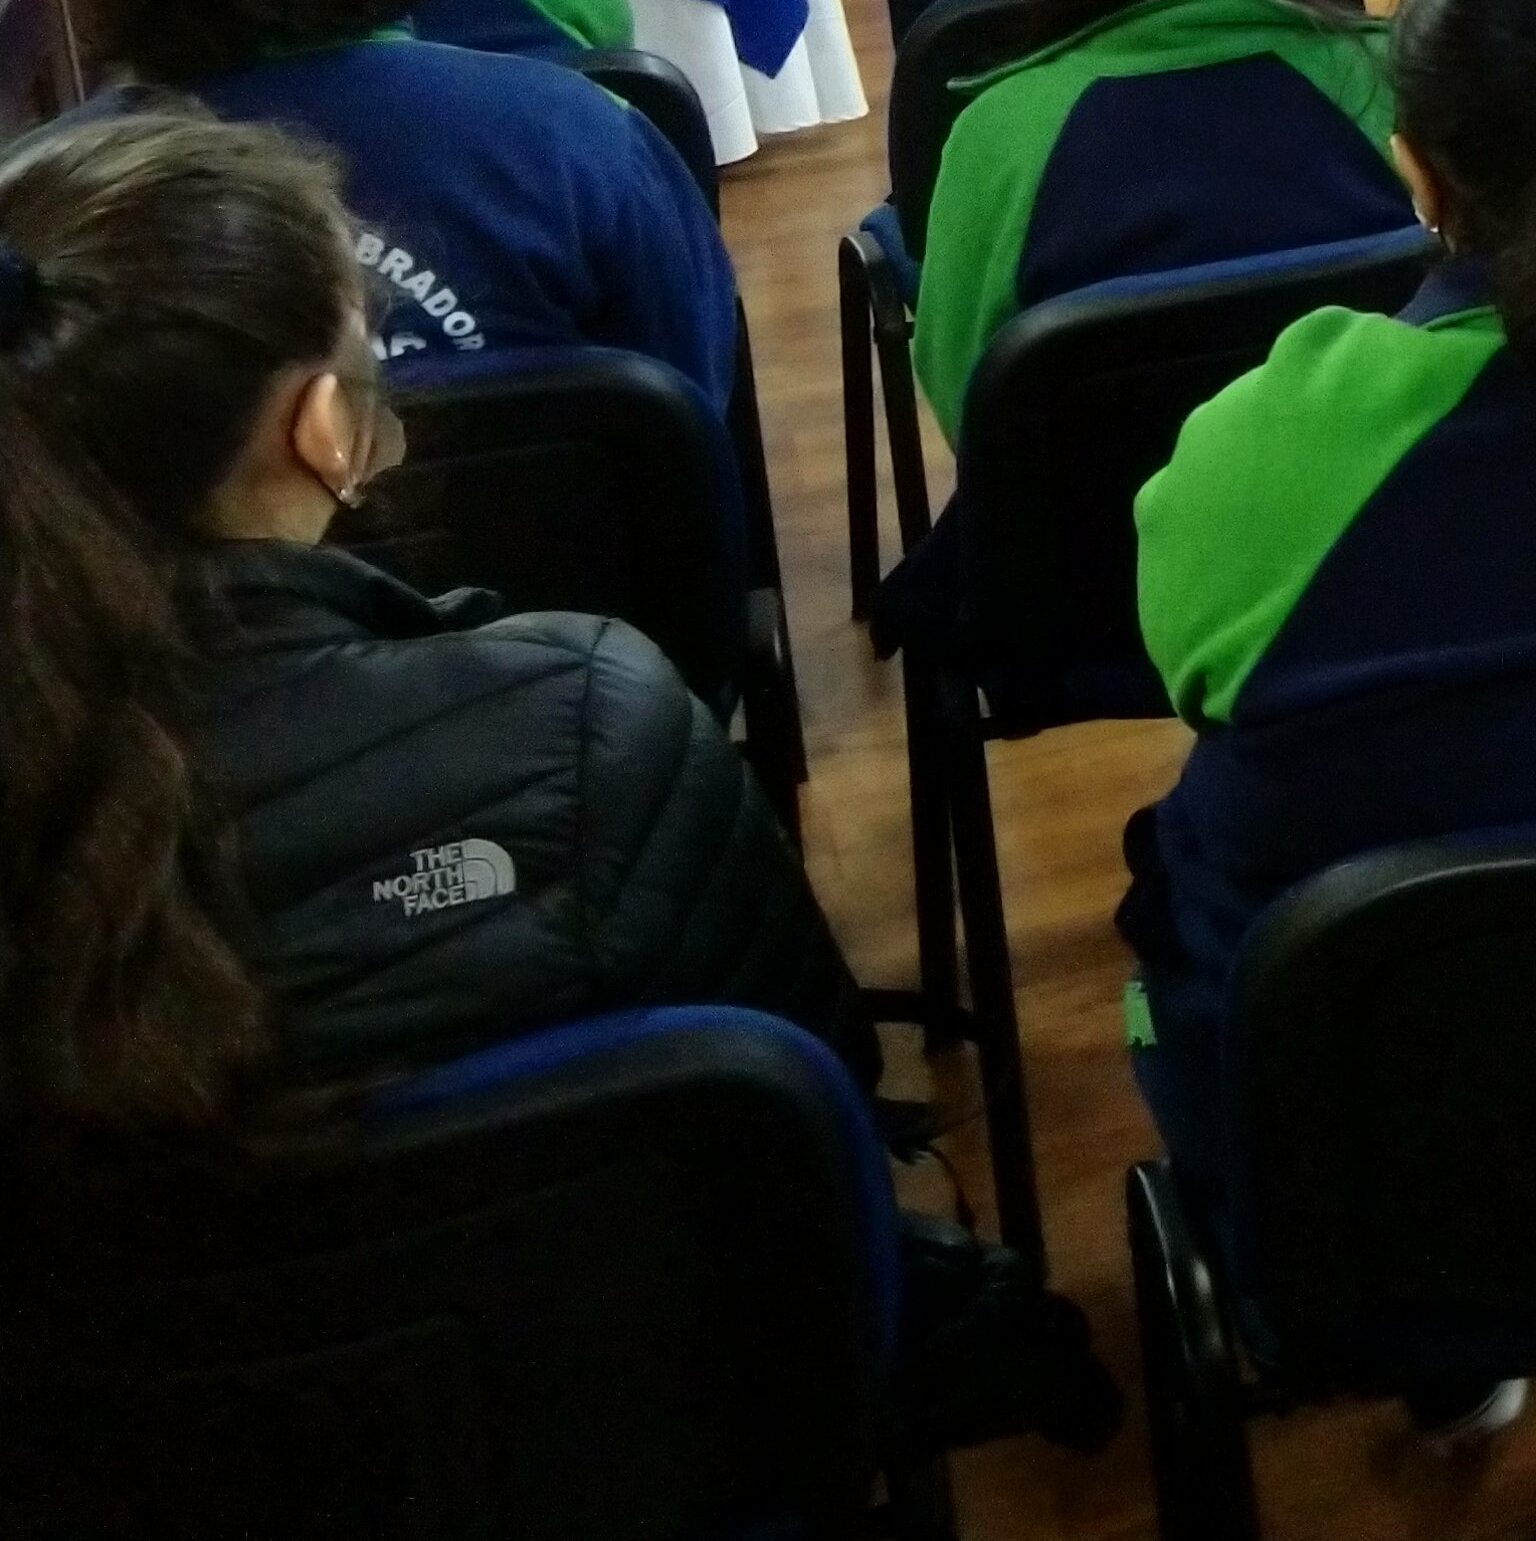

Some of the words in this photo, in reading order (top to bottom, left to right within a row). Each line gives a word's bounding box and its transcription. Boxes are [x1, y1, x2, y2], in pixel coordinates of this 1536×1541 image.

[409, 841, 463, 872] THE
[372, 862, 464, 903] NORTH
[404, 884, 464, 917] FACE
